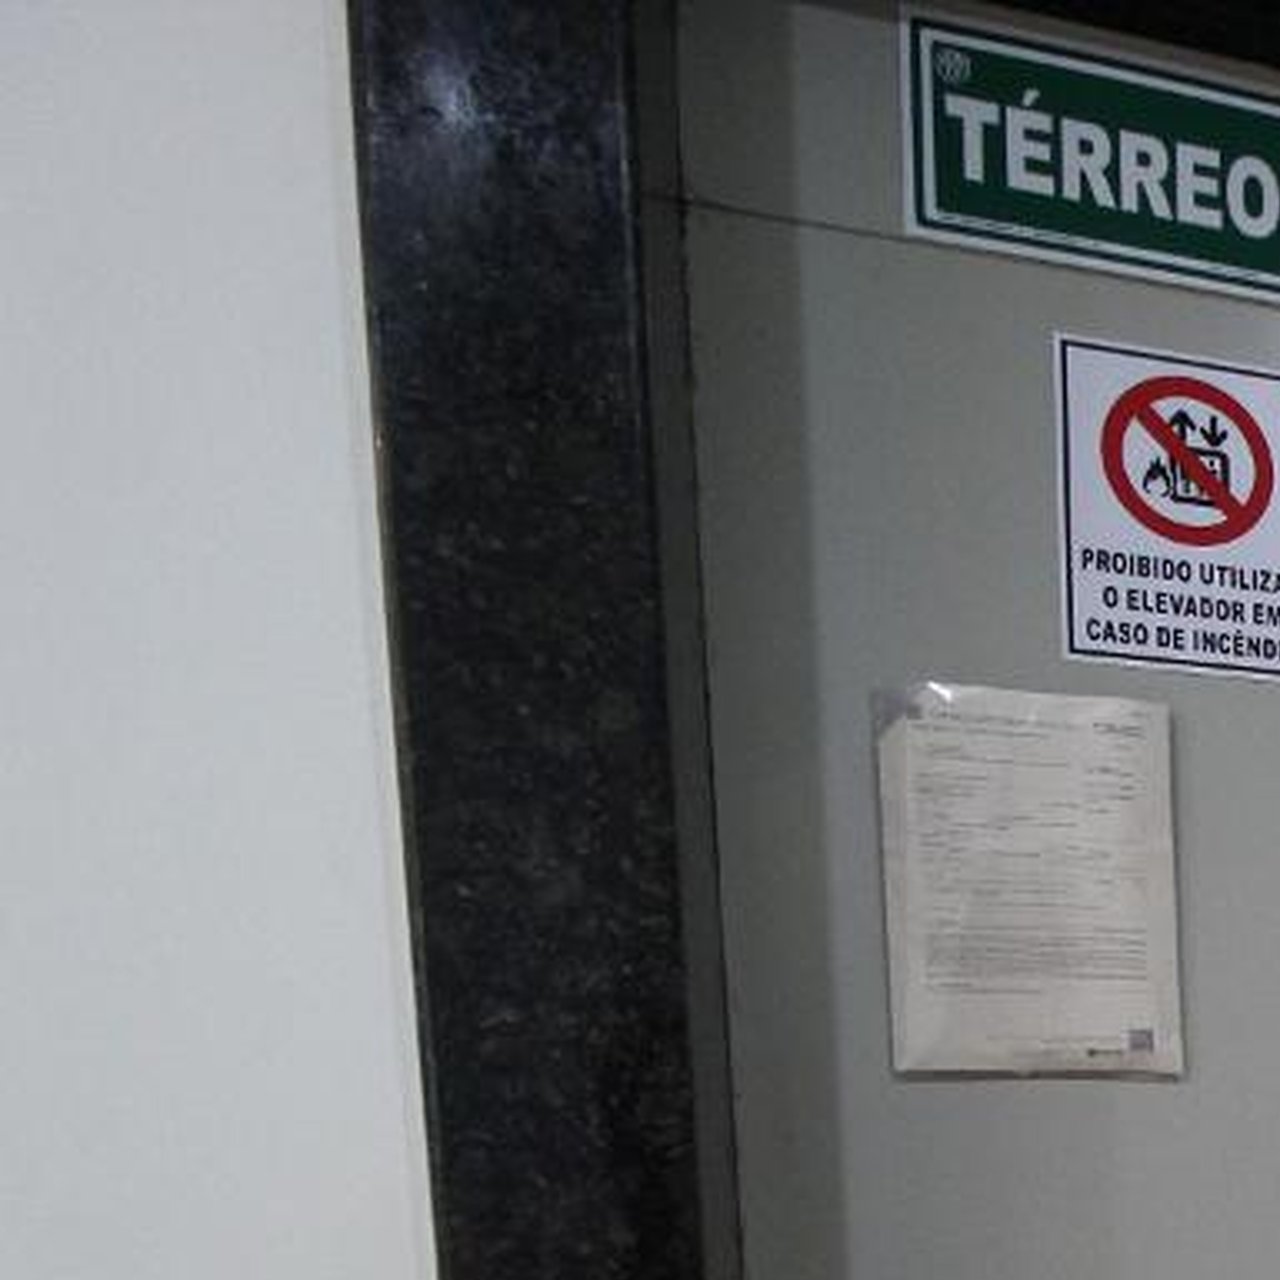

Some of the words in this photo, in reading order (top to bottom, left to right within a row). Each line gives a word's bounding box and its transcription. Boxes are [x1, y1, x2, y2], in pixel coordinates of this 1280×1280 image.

[944, 88, 1280, 239] TÉRREO
[1081, 548, 1192, 583] PROIBIDO
[1102, 585, 1118, 608] O
[1126, 588, 1246, 624] ELEVADOR
[1086, 618, 1148, 645] CASO
[1156, 626, 1185, 650] DE
